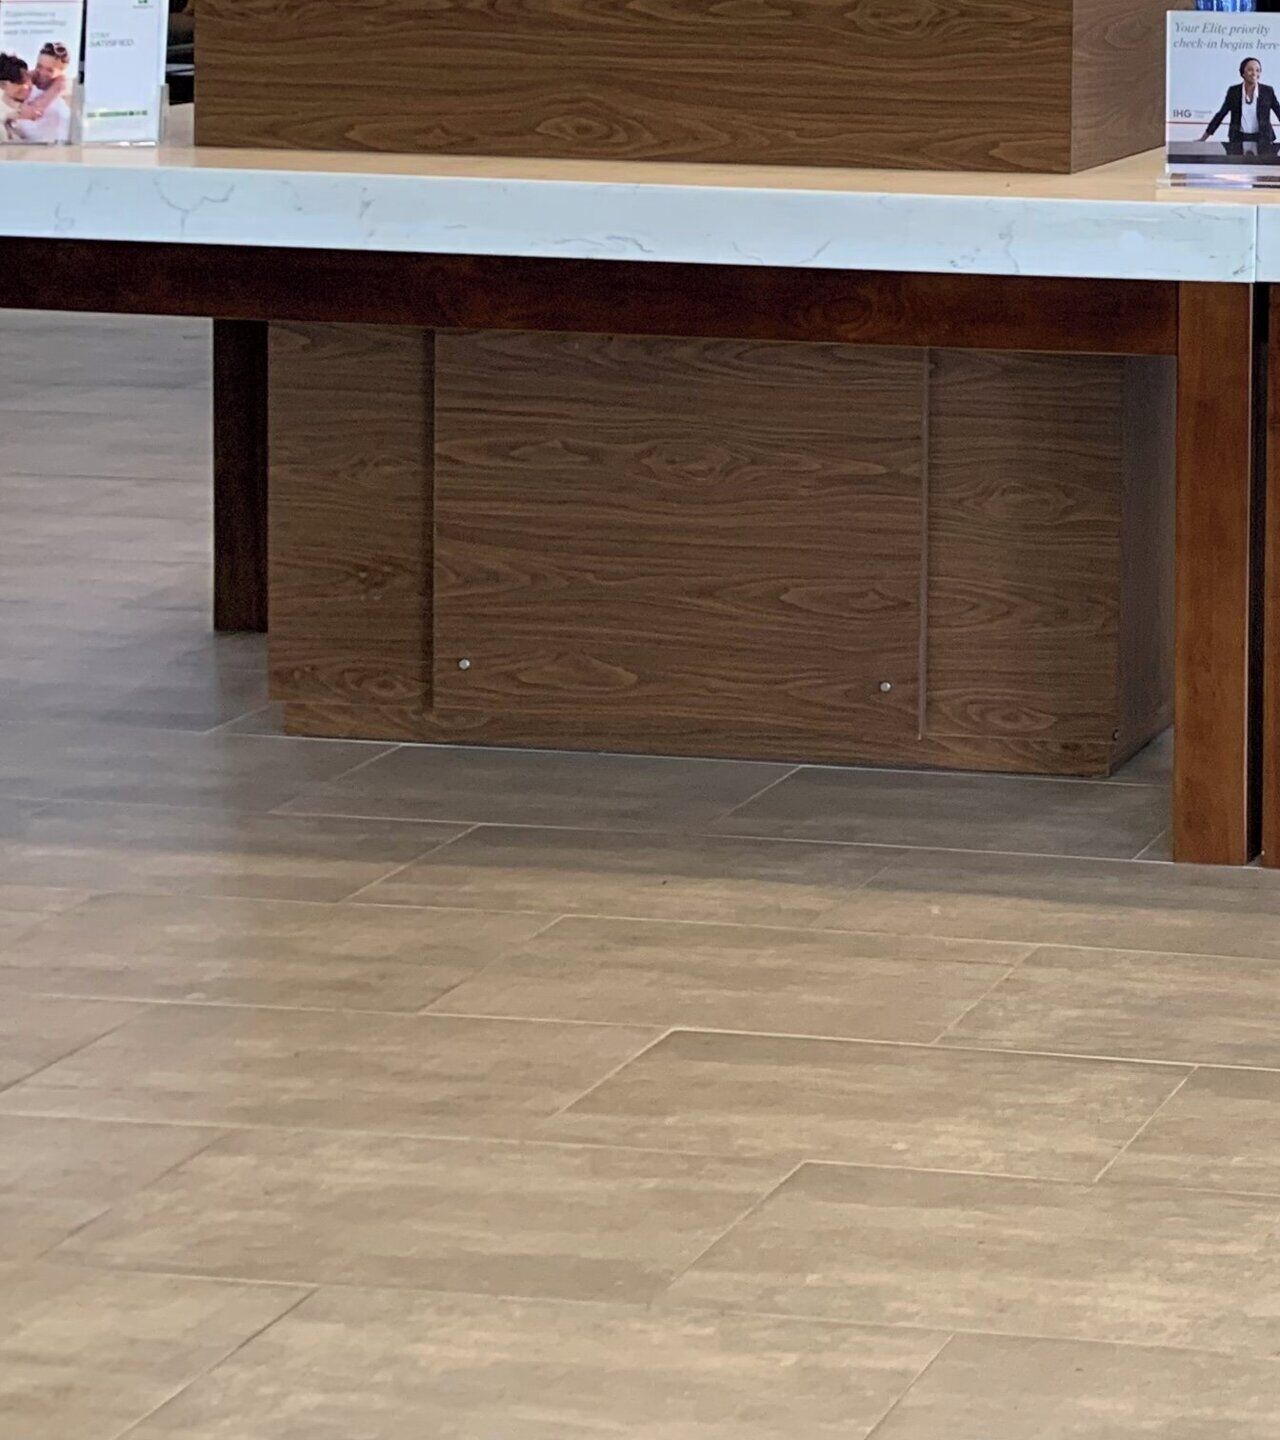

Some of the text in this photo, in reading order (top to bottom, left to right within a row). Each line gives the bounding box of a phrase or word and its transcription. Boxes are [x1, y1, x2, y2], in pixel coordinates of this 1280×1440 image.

[1175, 22, 1271, 37] Your Elite priority
[1173, 38, 1280, 51] check-in begins here
[1173, 109, 1192, 118] IHG
